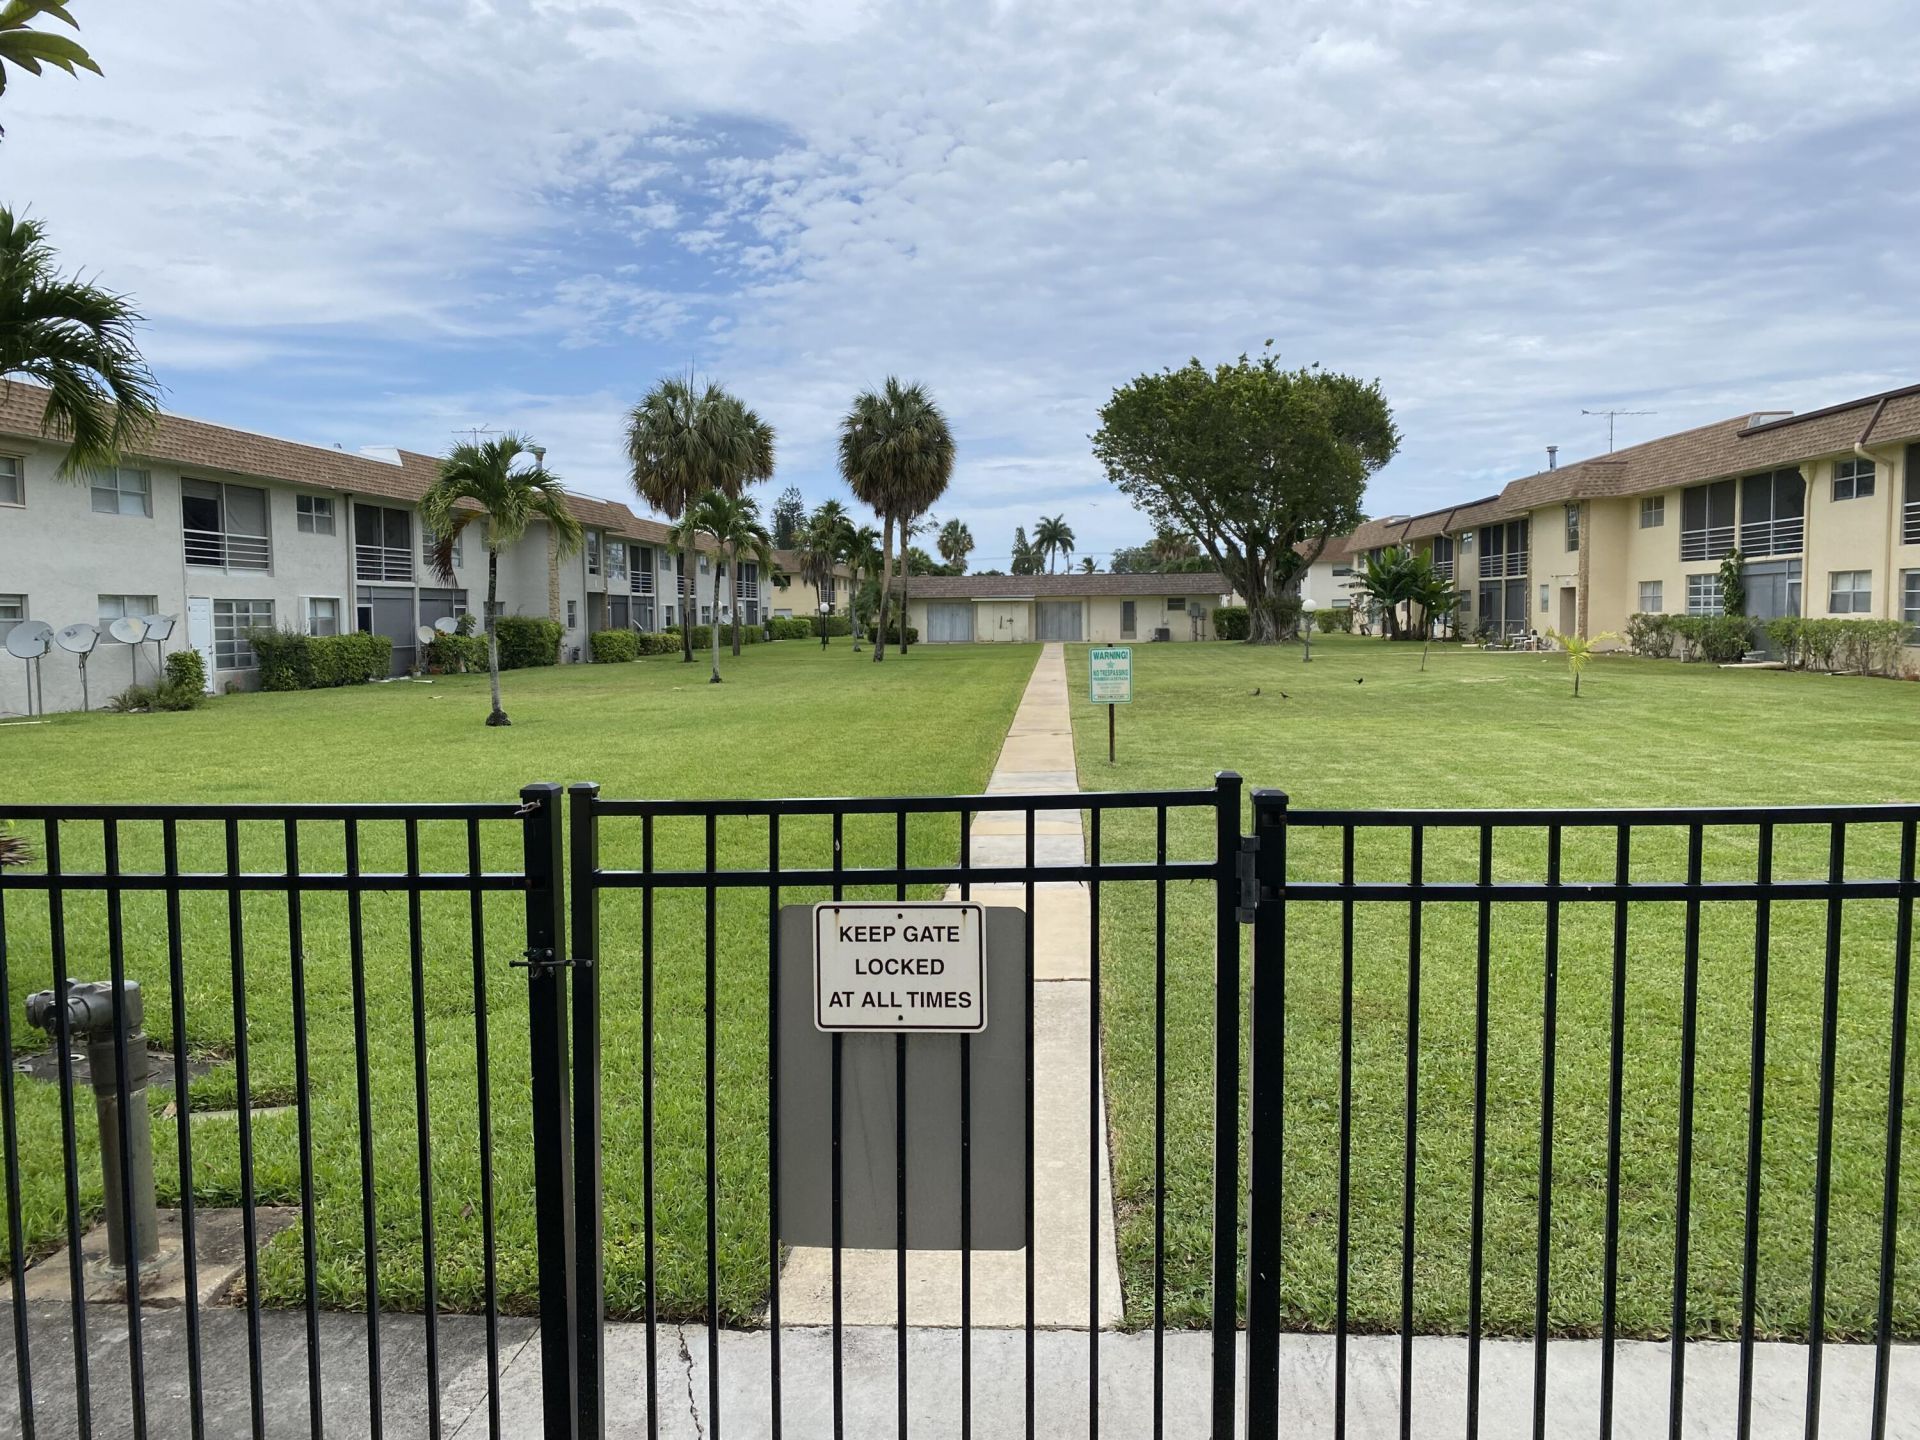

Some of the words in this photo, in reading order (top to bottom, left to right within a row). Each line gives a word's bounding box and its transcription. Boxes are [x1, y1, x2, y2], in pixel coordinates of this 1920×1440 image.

[1093, 651, 1128, 660] WARNING!
[840, 926, 896, 942] KEEP
[903, 926, 960, 942] GATE
[855, 958, 944, 975] LOCKED
[829, 991, 855, 1008] AT
[861, 991, 902, 1008] ALL
[906, 992, 972, 1008] TIMES
